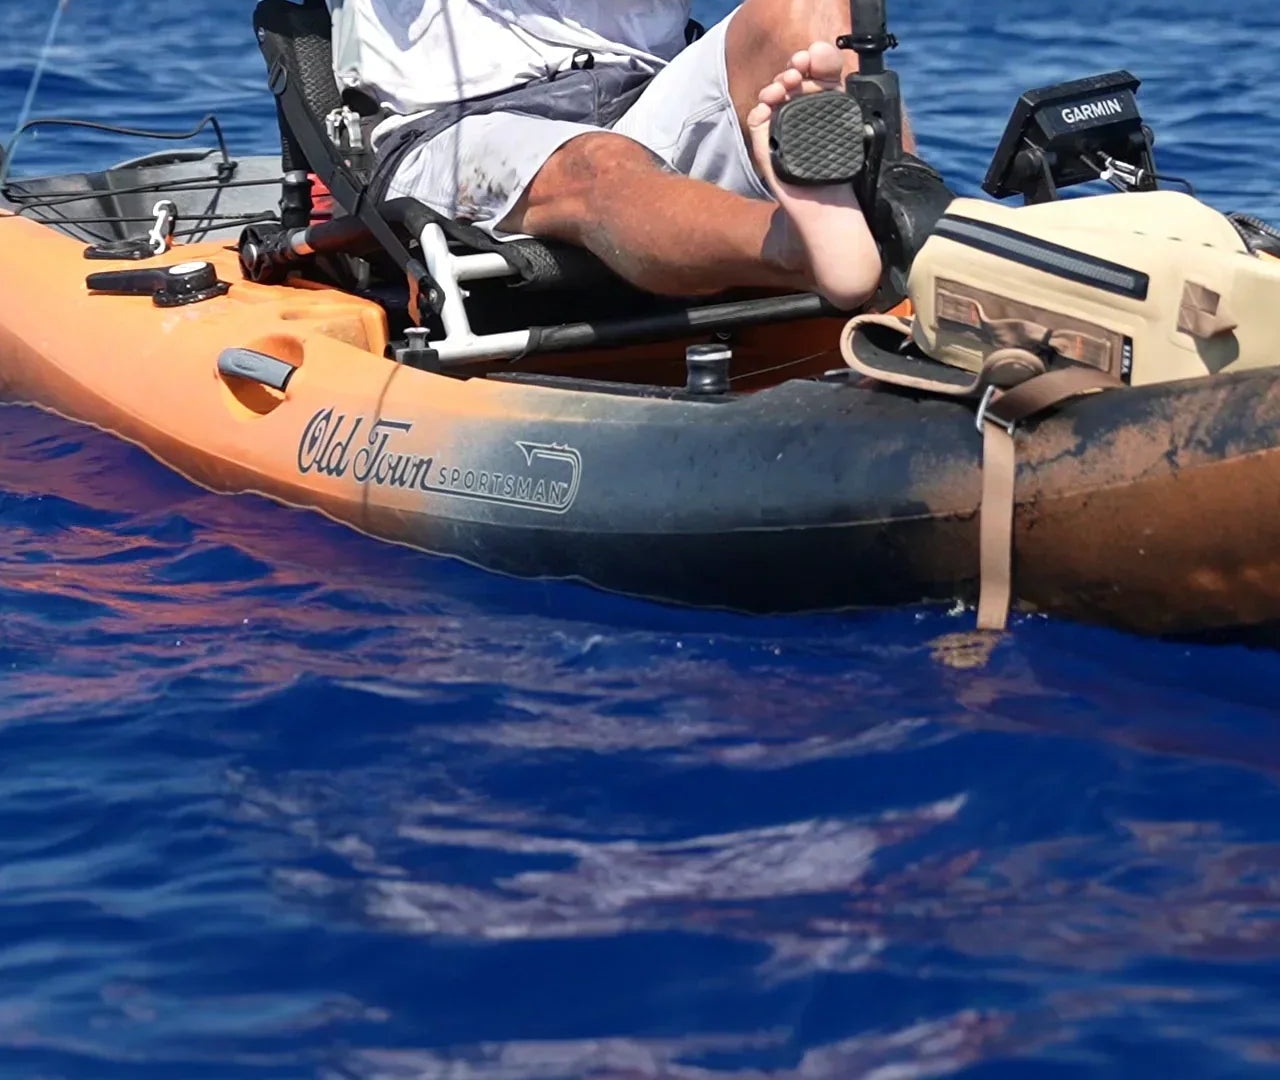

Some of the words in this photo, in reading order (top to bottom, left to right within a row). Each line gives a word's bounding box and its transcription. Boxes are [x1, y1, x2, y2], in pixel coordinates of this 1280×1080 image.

[1061, 98, 1122, 123] GARMIN
[297, 406, 350, 478] Old
[353, 418, 433, 491] Town
[438, 466, 564, 505] SPORTSMAN
